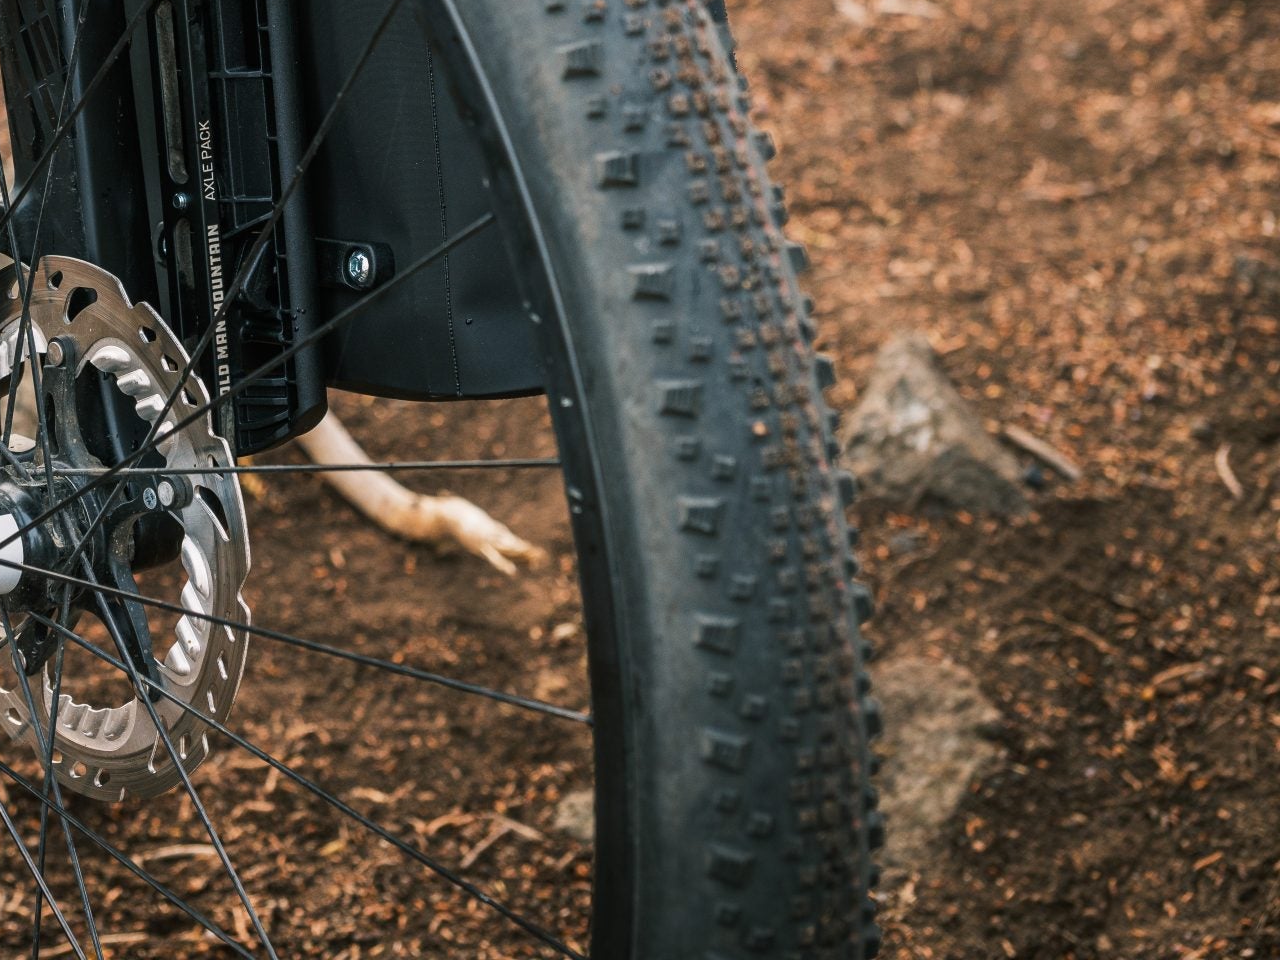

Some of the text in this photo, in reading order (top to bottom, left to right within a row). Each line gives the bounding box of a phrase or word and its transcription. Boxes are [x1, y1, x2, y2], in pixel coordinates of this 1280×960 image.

[198, 119, 214, 160] PACK
[202, 161, 216, 201] AXLE
[215, 320, 230, 360] MAN
[218, 364, 231, 398] OLD
